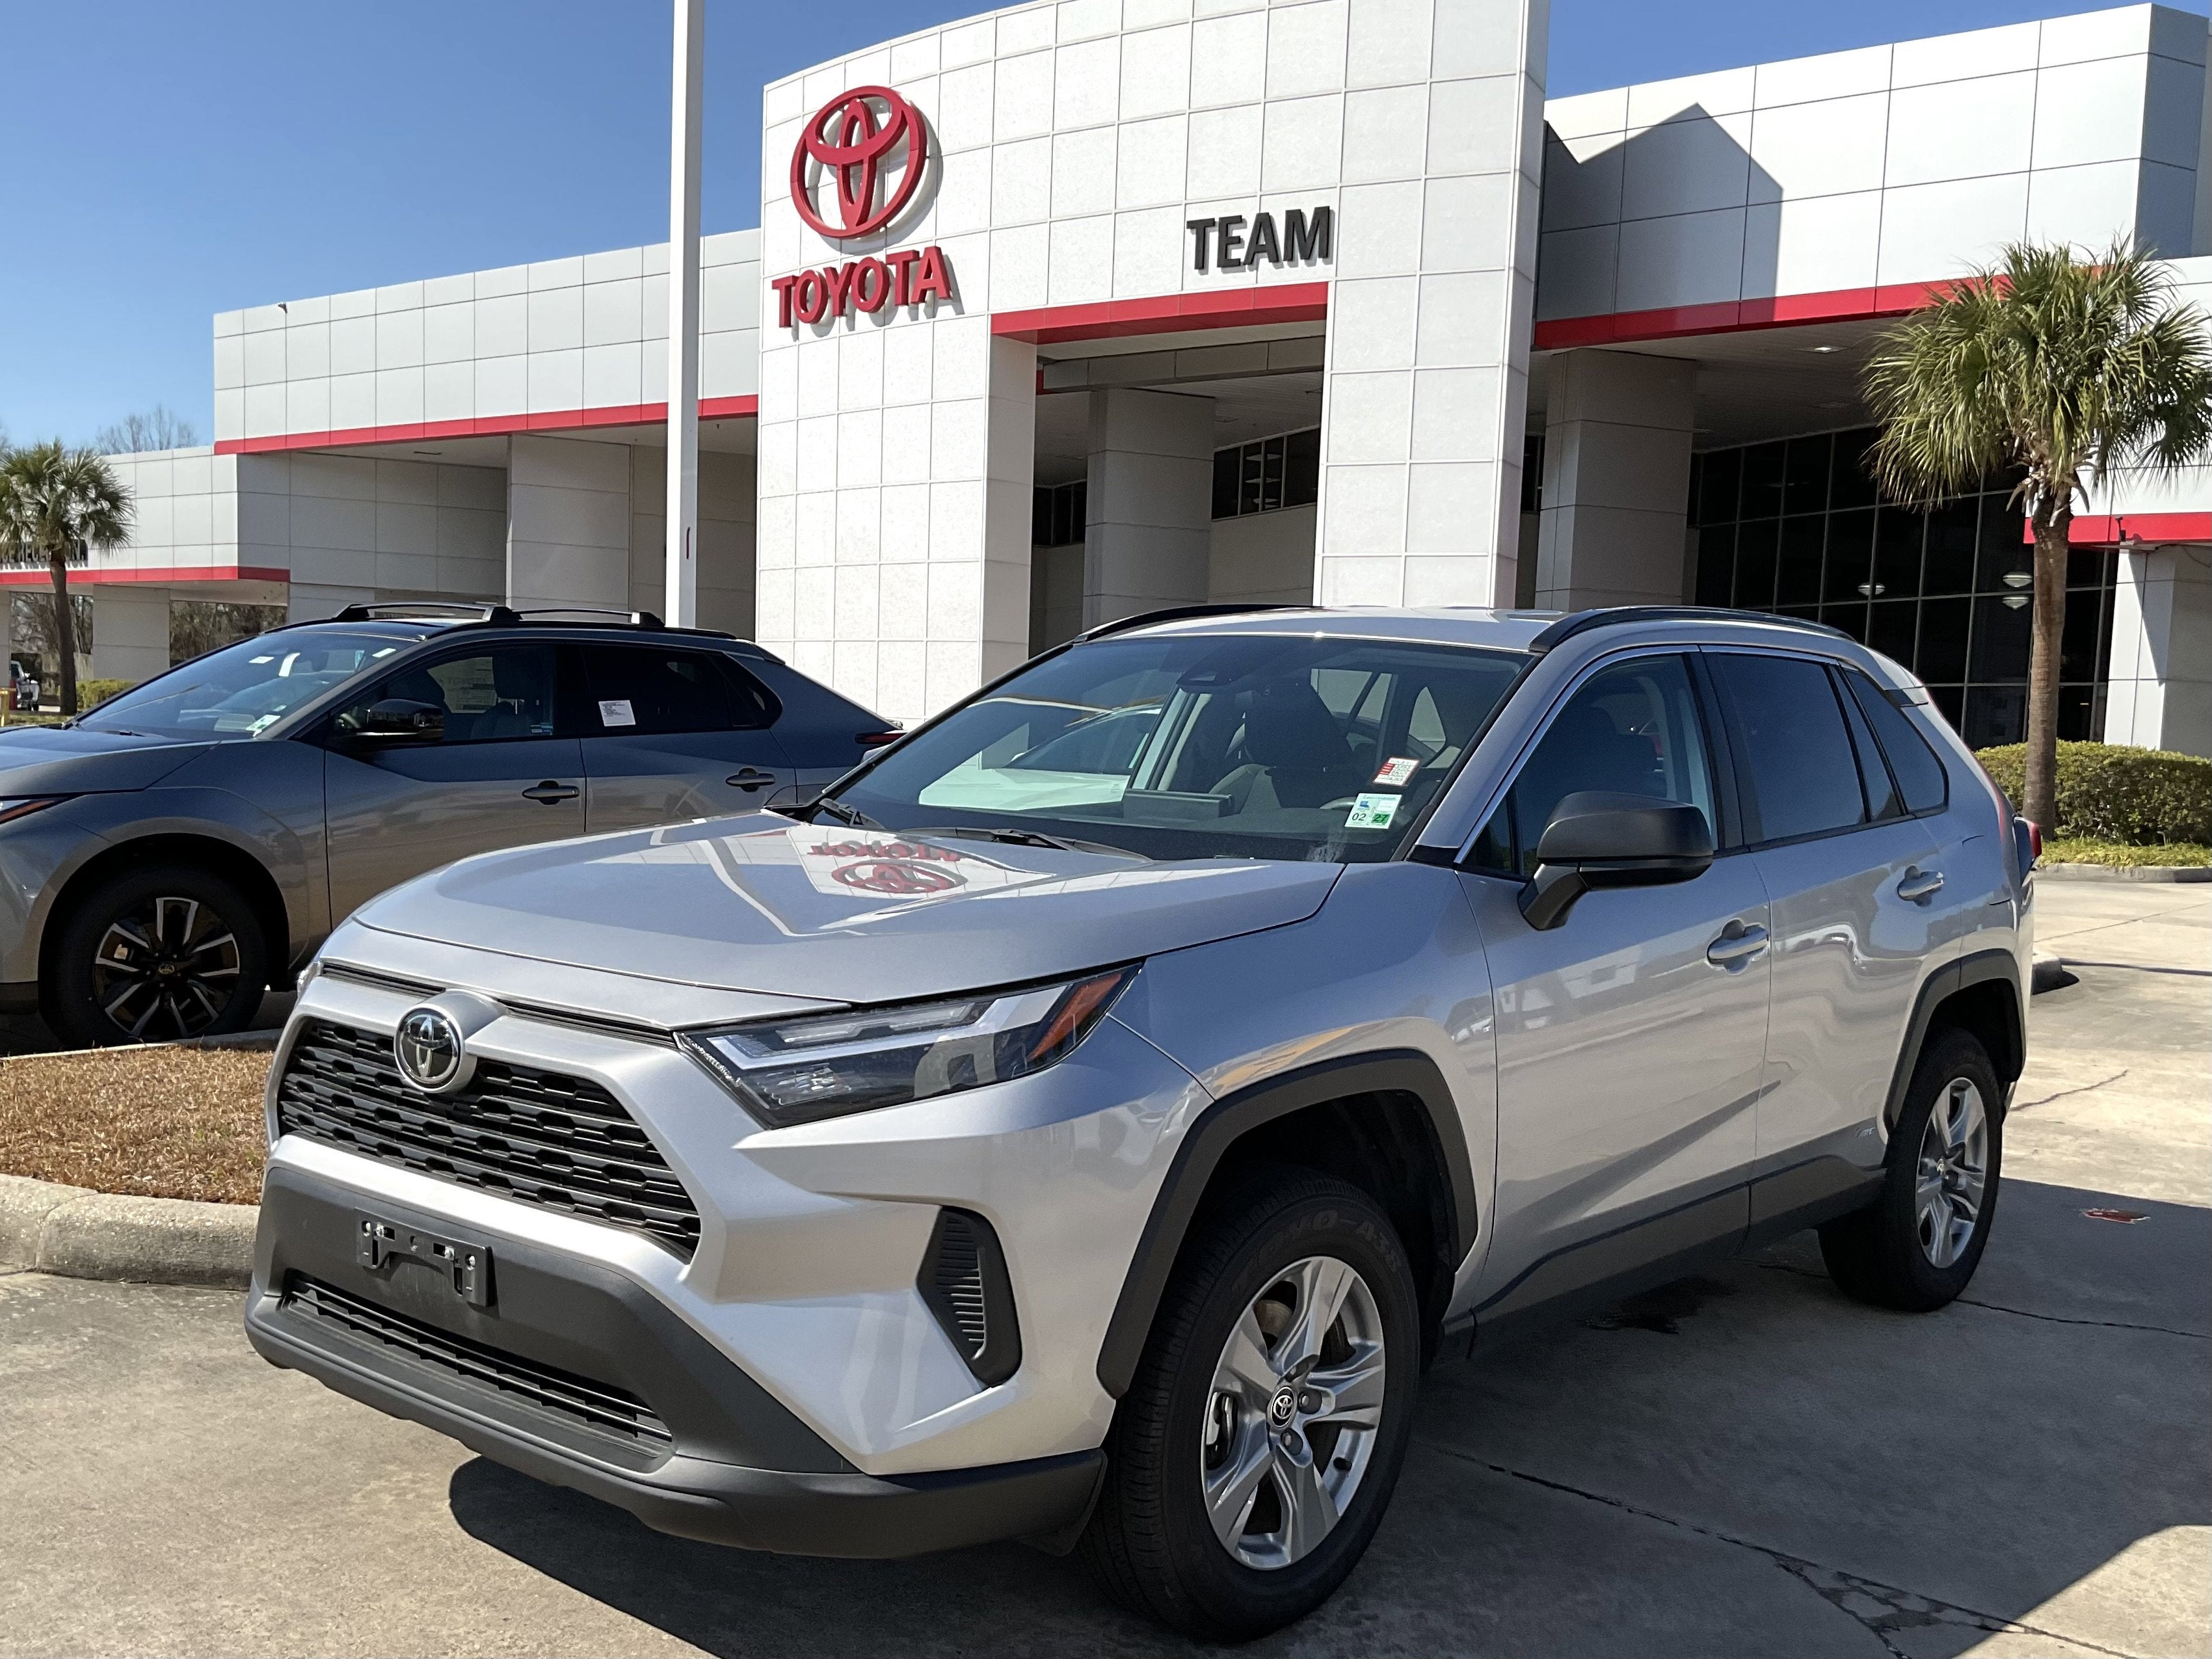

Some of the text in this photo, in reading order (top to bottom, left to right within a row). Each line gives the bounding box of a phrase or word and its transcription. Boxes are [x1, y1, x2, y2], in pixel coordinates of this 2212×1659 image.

[1186, 206, 1330, 270] TEAM
[772, 246, 952, 328] TOYOTA
[1373, 814, 1389, 822] 27
